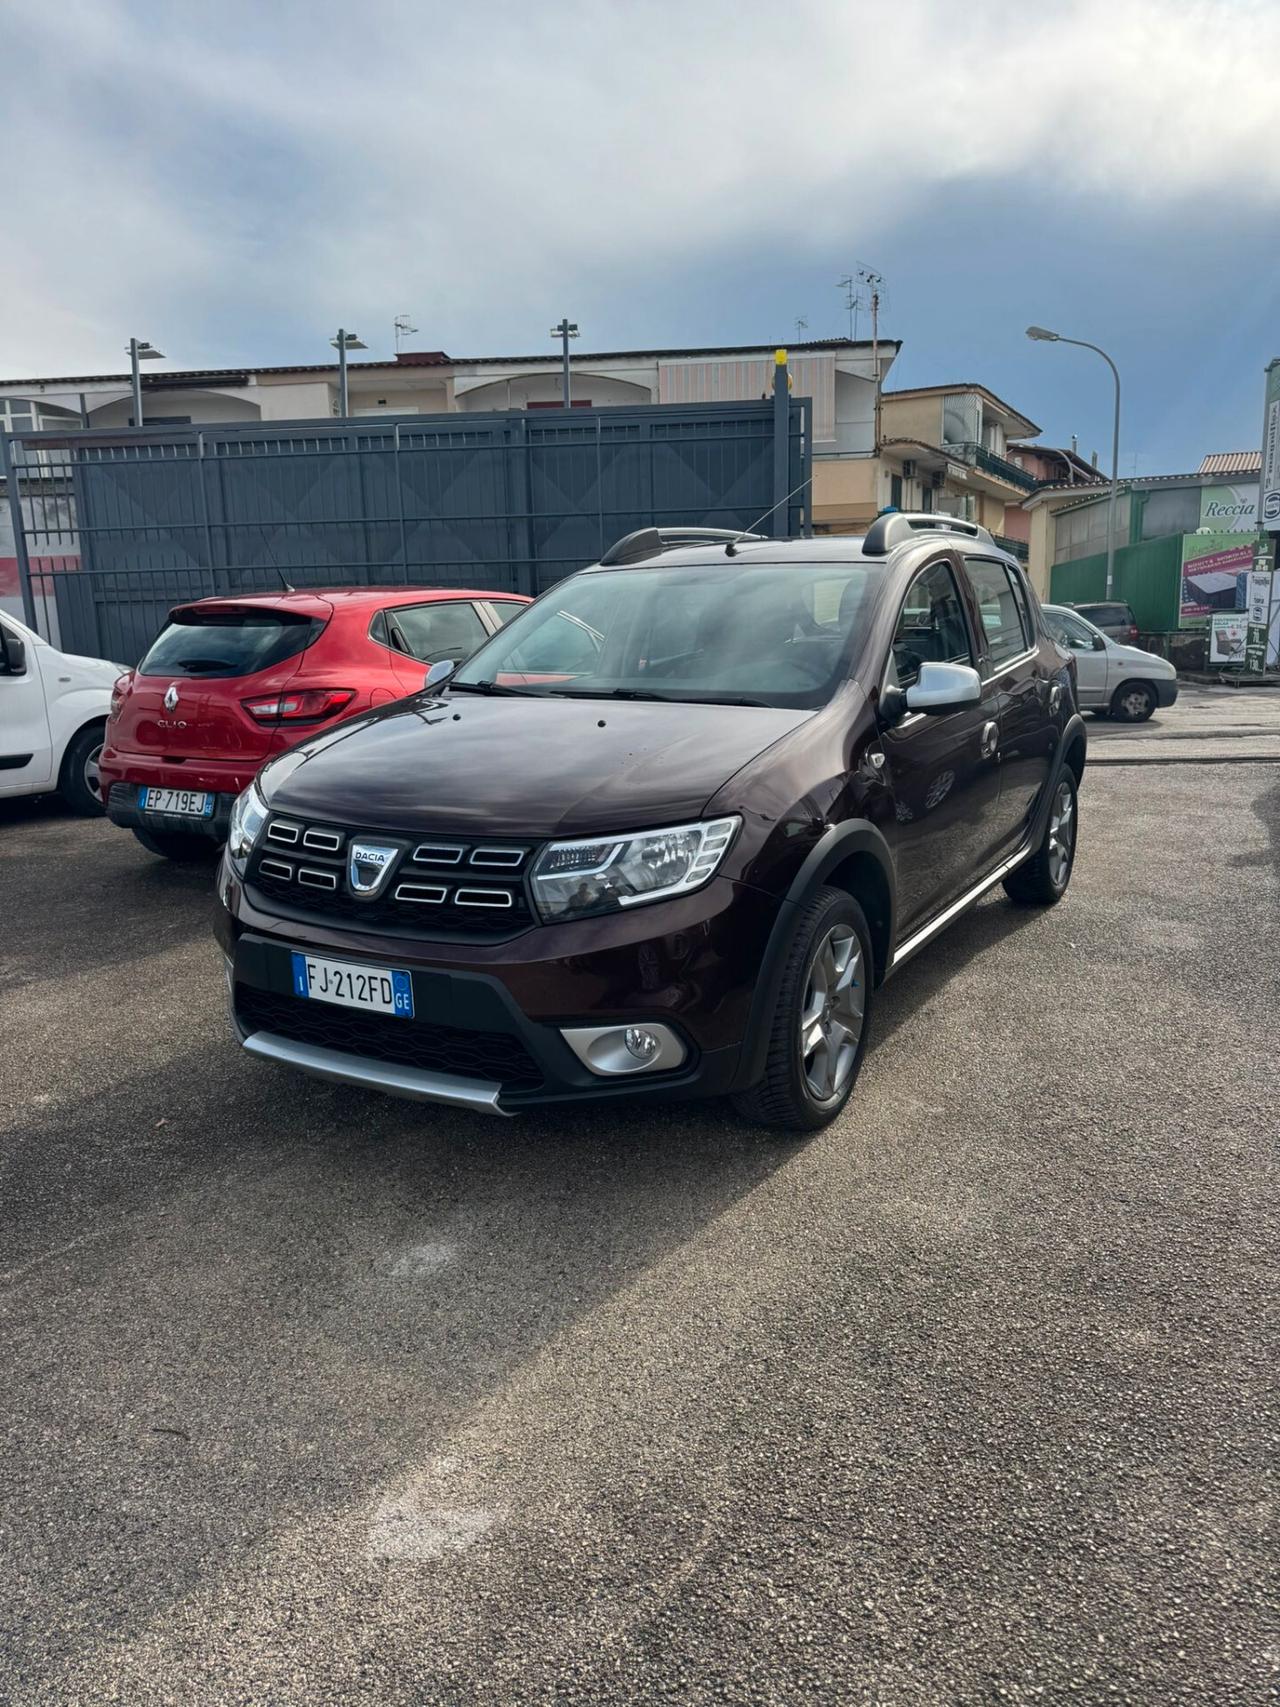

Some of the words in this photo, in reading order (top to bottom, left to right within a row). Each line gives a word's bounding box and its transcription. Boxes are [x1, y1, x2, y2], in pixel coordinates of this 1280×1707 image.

[1205, 501, 1255, 517] Reccia
[157, 719, 187, 729] CLIO
[355, 851, 385, 862] DACIA
[395, 992, 410, 1010] GE
